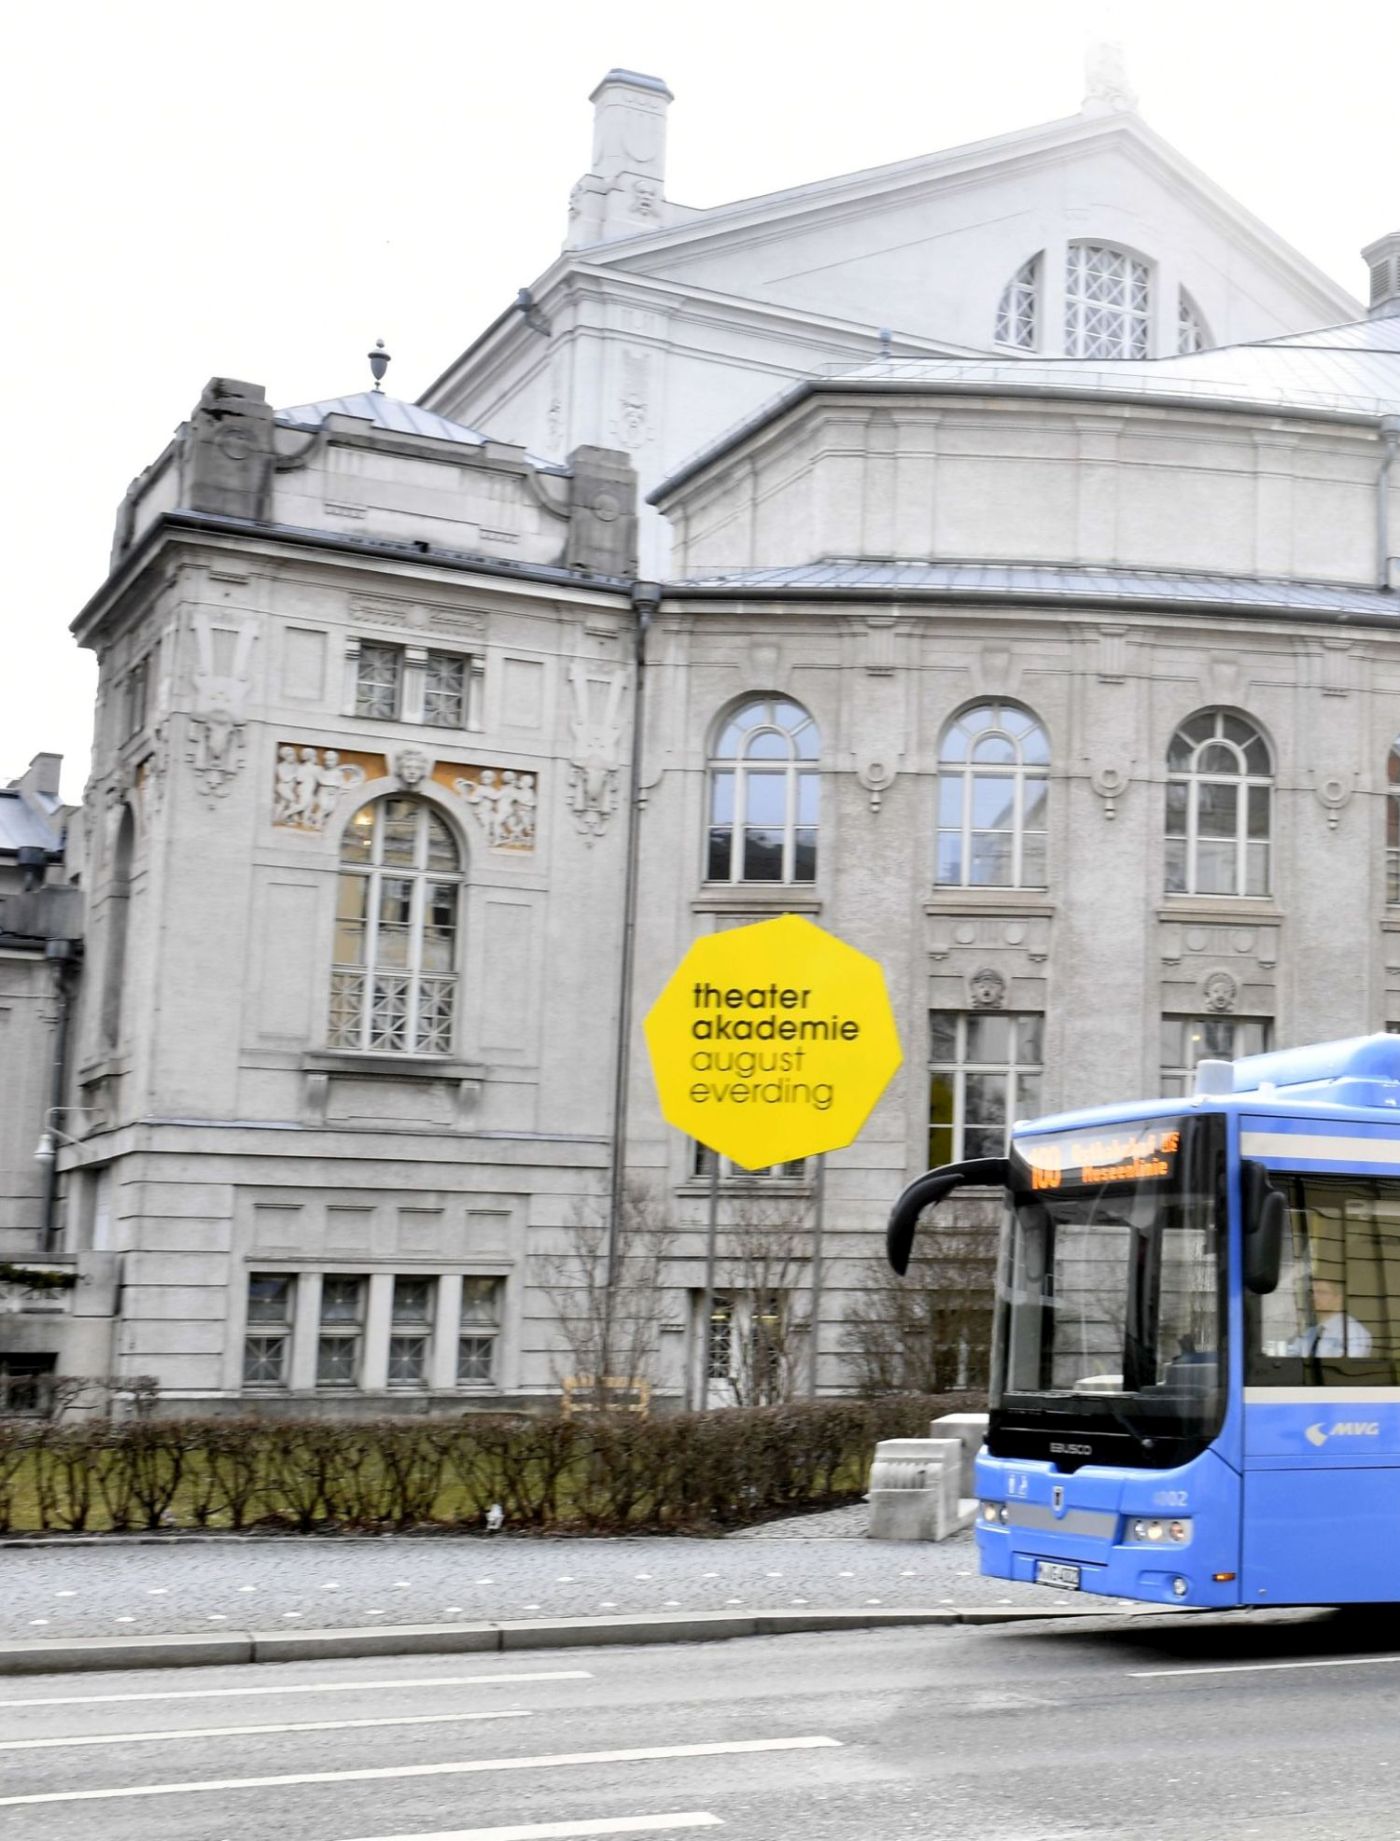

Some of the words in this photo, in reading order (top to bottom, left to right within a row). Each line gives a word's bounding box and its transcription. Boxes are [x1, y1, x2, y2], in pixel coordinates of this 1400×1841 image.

[694, 982, 812, 1009] theater
[692, 1014, 861, 1041] akademie
[690, 1046, 806, 1079] august
[689, 1077, 834, 1111] everding
[1030, 1146, 1061, 1190] 100
[1329, 1422, 1379, 1435] MVG
[1050, 1442, 1092, 1455] EBUSCO
